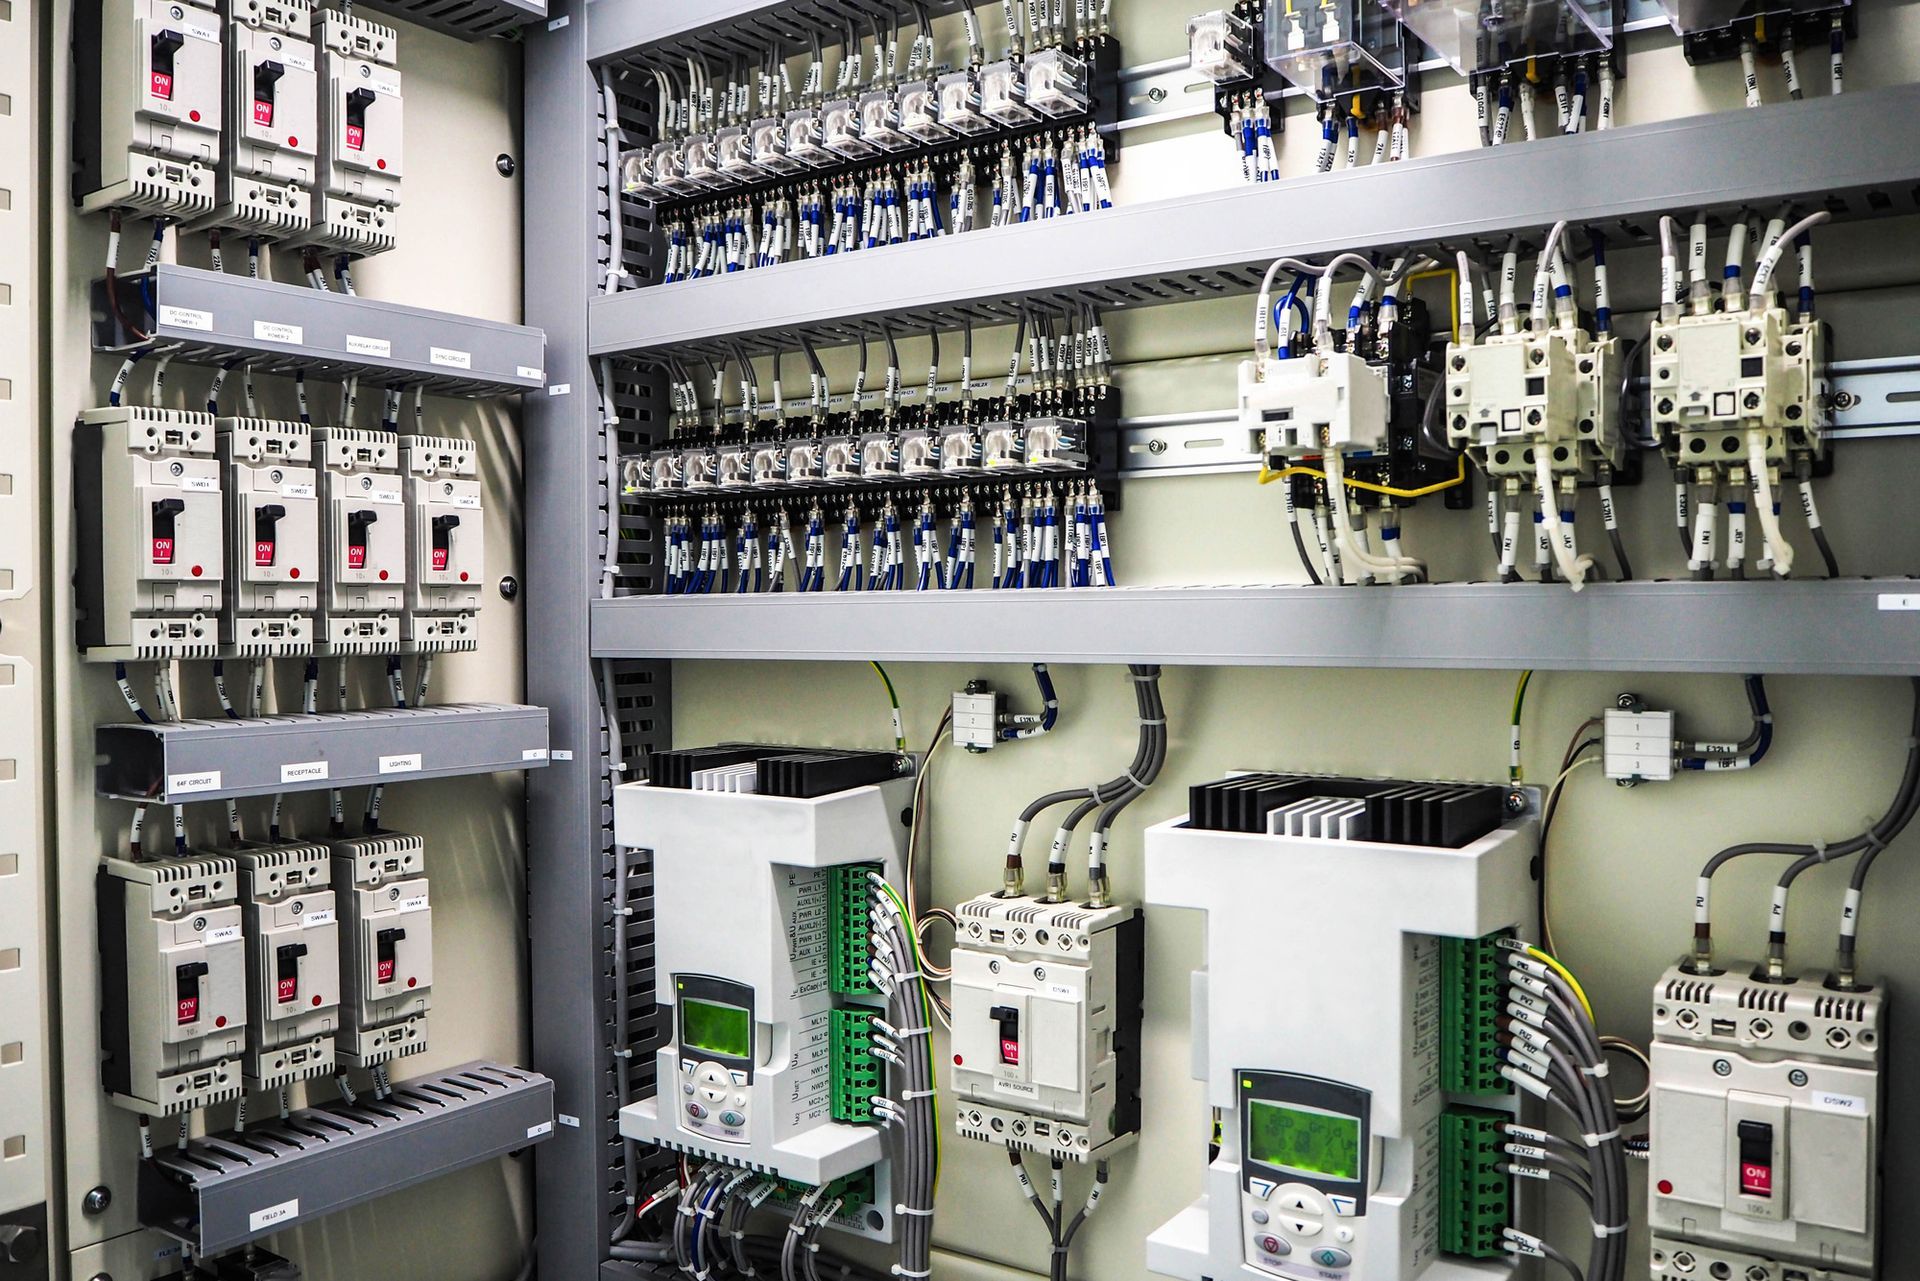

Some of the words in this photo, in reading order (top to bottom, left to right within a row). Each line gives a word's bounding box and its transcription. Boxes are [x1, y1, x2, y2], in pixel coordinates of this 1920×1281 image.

[1834, 63, 1843, 80] 1BP1
[155, 76, 169, 86] ON
[256, 104, 269, 114] ON
[348, 128, 360, 138] ON
[1695, 241, 1703, 256] KB1
[1701, 530, 1711, 546] EN1
[1735, 529, 1744, 544] JB2
[156, 541, 170, 550] ON
[1563, 534, 1572, 549] JA2
[258, 544, 271, 553] ON
[350, 548, 363, 556] ON
[433, 550, 445, 559] ON
[287, 767, 321, 776] RECEPTACLE
[189, 778, 212, 786] CIRCUIT
[789, 874, 796, 885] PE
[1695, 896, 1703, 907] PU
[1772, 904, 1781, 914] PV
[1843, 907, 1852, 918] PW
[799, 911, 812, 919] PWR
[799, 936, 812, 944] PWR
[799, 948, 811, 956] AUX
[379, 962, 391, 971] ON
[280, 981, 293, 990] ON
[180, 1001, 194, 1010] ON
[811, 1018, 823, 1026] ML1
[1005, 1043, 1017, 1052] ON
[812, 1050, 824, 1059] ML3
[811, 1067, 824, 1075] NW1
[811, 1082, 824, 1091] NW3
[998, 1081, 1011, 1089] AVR1
[1013, 1084, 1034, 1093] SOURCE
[1746, 1168, 1766, 1178] ON
[262, 1212, 278, 1222] FIELD
[279, 1209, 286, 1217] 3A
[1263, 1258, 1282, 1267] STOP
[1319, 1271, 1343, 1281] START
